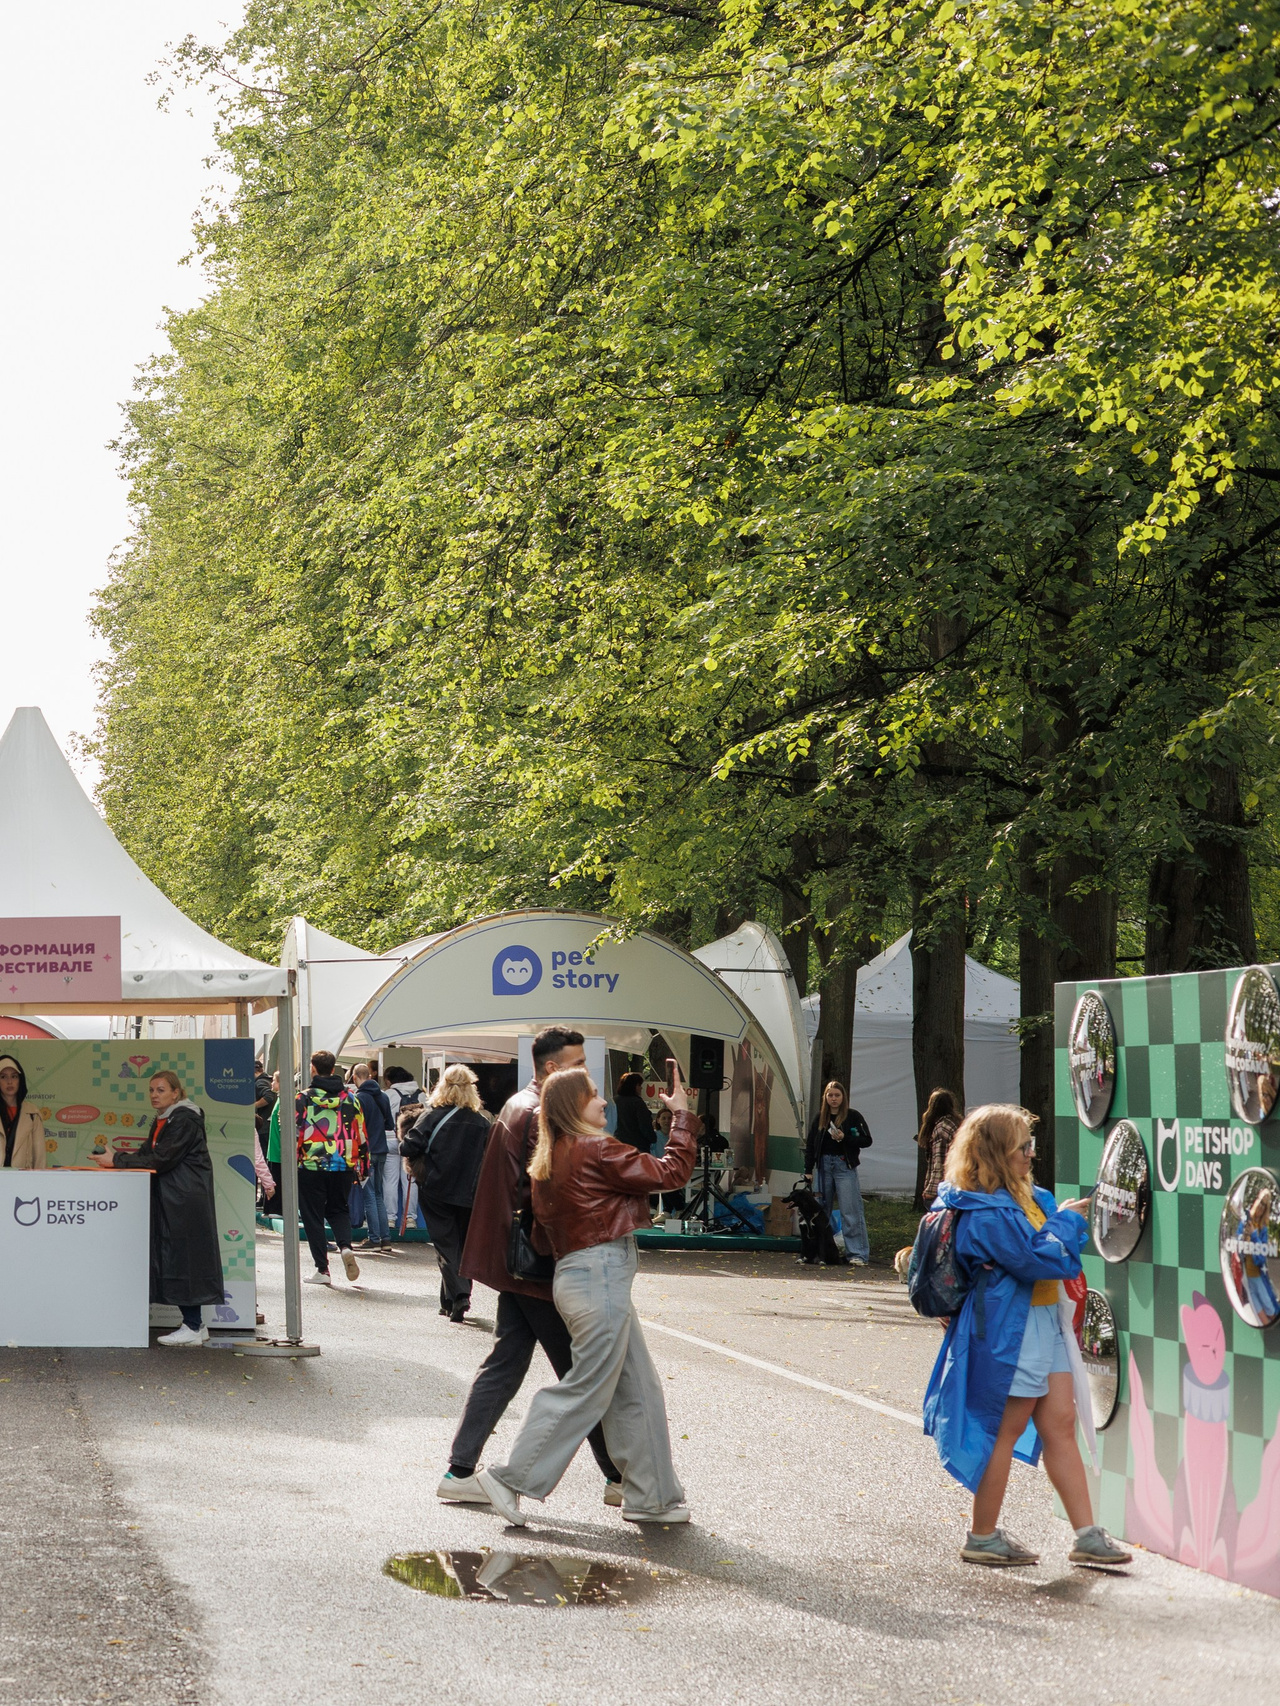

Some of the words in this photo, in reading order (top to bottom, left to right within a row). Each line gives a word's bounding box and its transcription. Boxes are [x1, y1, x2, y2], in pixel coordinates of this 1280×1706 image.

[552, 969, 620, 992] story
[658, 1086, 699, 1099] peop
[1185, 1126, 1254, 1155] PETSHOP
[1185, 1161, 1222, 1190] DAYS
[47, 1200, 118, 1212] PETSHOP
[47, 1214, 86, 1224] DAYS
[1238, 1240, 1278, 1257] PERSON
